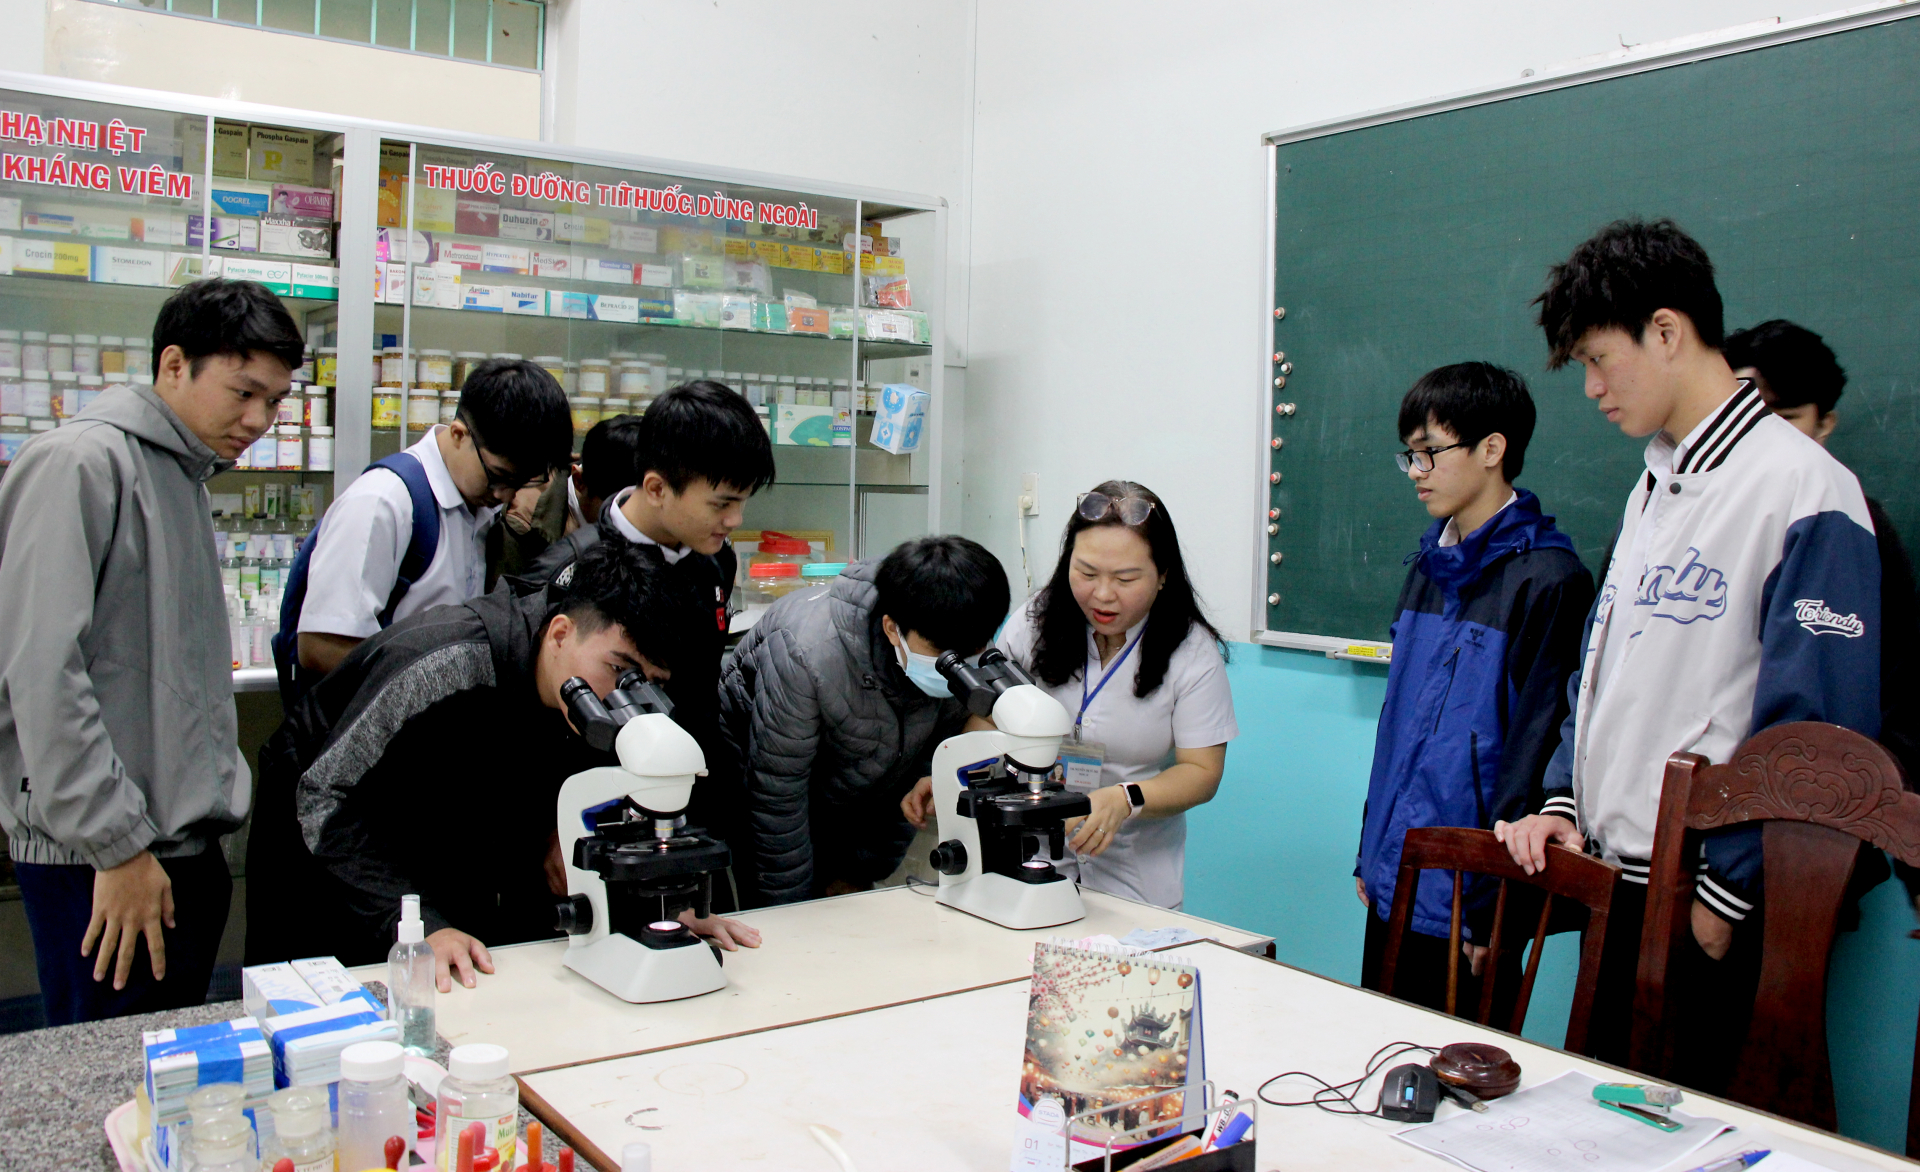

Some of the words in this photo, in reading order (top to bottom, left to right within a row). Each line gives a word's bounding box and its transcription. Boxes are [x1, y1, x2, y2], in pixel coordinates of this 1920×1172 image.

[0, 110, 44, 147] HẠ
[218, 127, 243, 137] Gaspain
[256, 131, 283, 141] Phospha
[284, 135, 309, 144] Gaspain
[3, 153, 111, 191] KHÁNG
[117, 163, 192, 199] VIÊM
[423, 162, 505, 195] THUỐC
[511, 171, 590, 205] ĐƯỜNG
[222, 195, 251, 205] DOGREL
[619, 184, 692, 216] THUỐC
[697, 190, 754, 222] DÙNG
[759, 201, 818, 230] NGOÀI
[264, 216, 296, 227] Maxxhar
[502, 213, 539, 226] Duhuzin
[25, 248, 53, 259] Crocin
[53, 252, 79, 263] 200mg
[111, 256, 152, 266] STOMEDON
[444, 249, 479, 261] Metronidazol
[511, 291, 539, 299] Nabifar
[1038, 1110, 1060, 1118] STADA
[1024, 1137, 1039, 1150] 01
